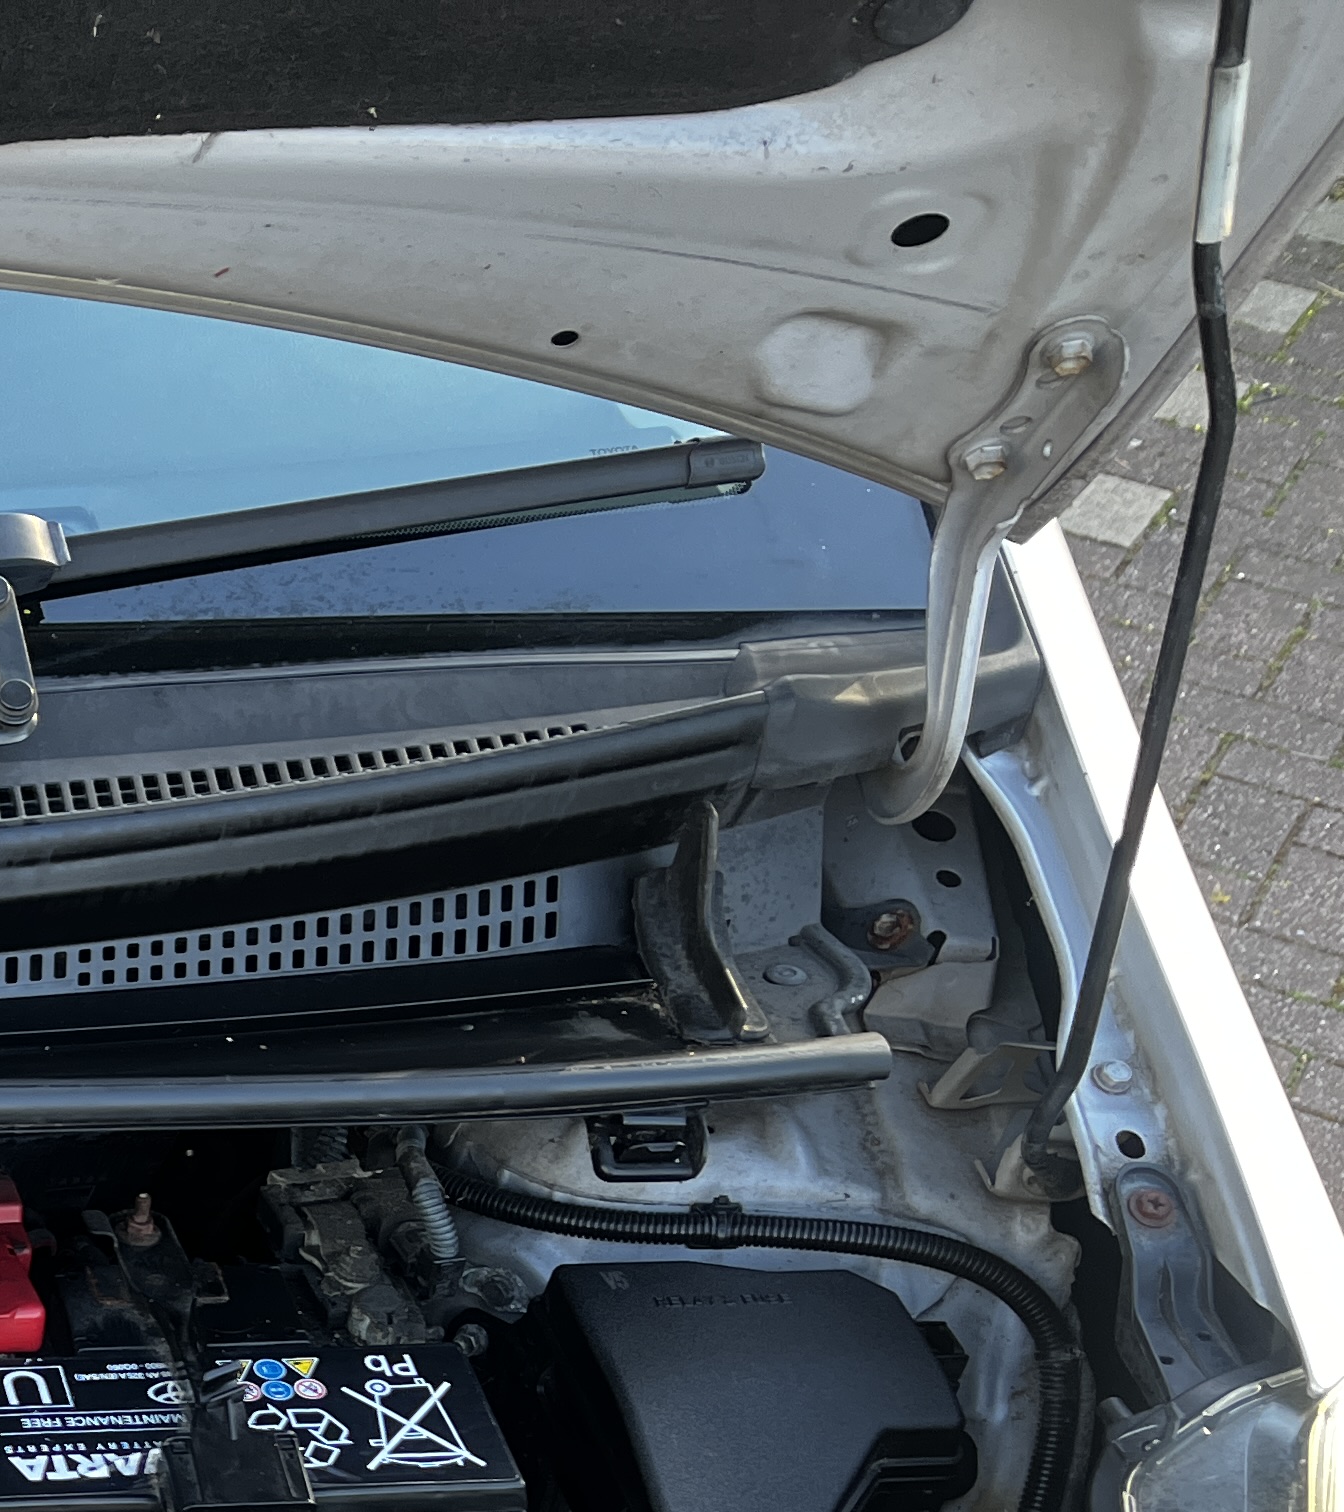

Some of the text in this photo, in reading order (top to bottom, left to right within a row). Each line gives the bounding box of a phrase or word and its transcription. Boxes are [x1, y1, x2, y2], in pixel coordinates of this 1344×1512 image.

[364, 1353, 419, 1377] Pb
[2, 1370, 53, 1406] U
[21, 1413, 187, 1429] MAINTENANCE FREE
[4, 1439, 164, 1454] ATTERY EXPERTS
